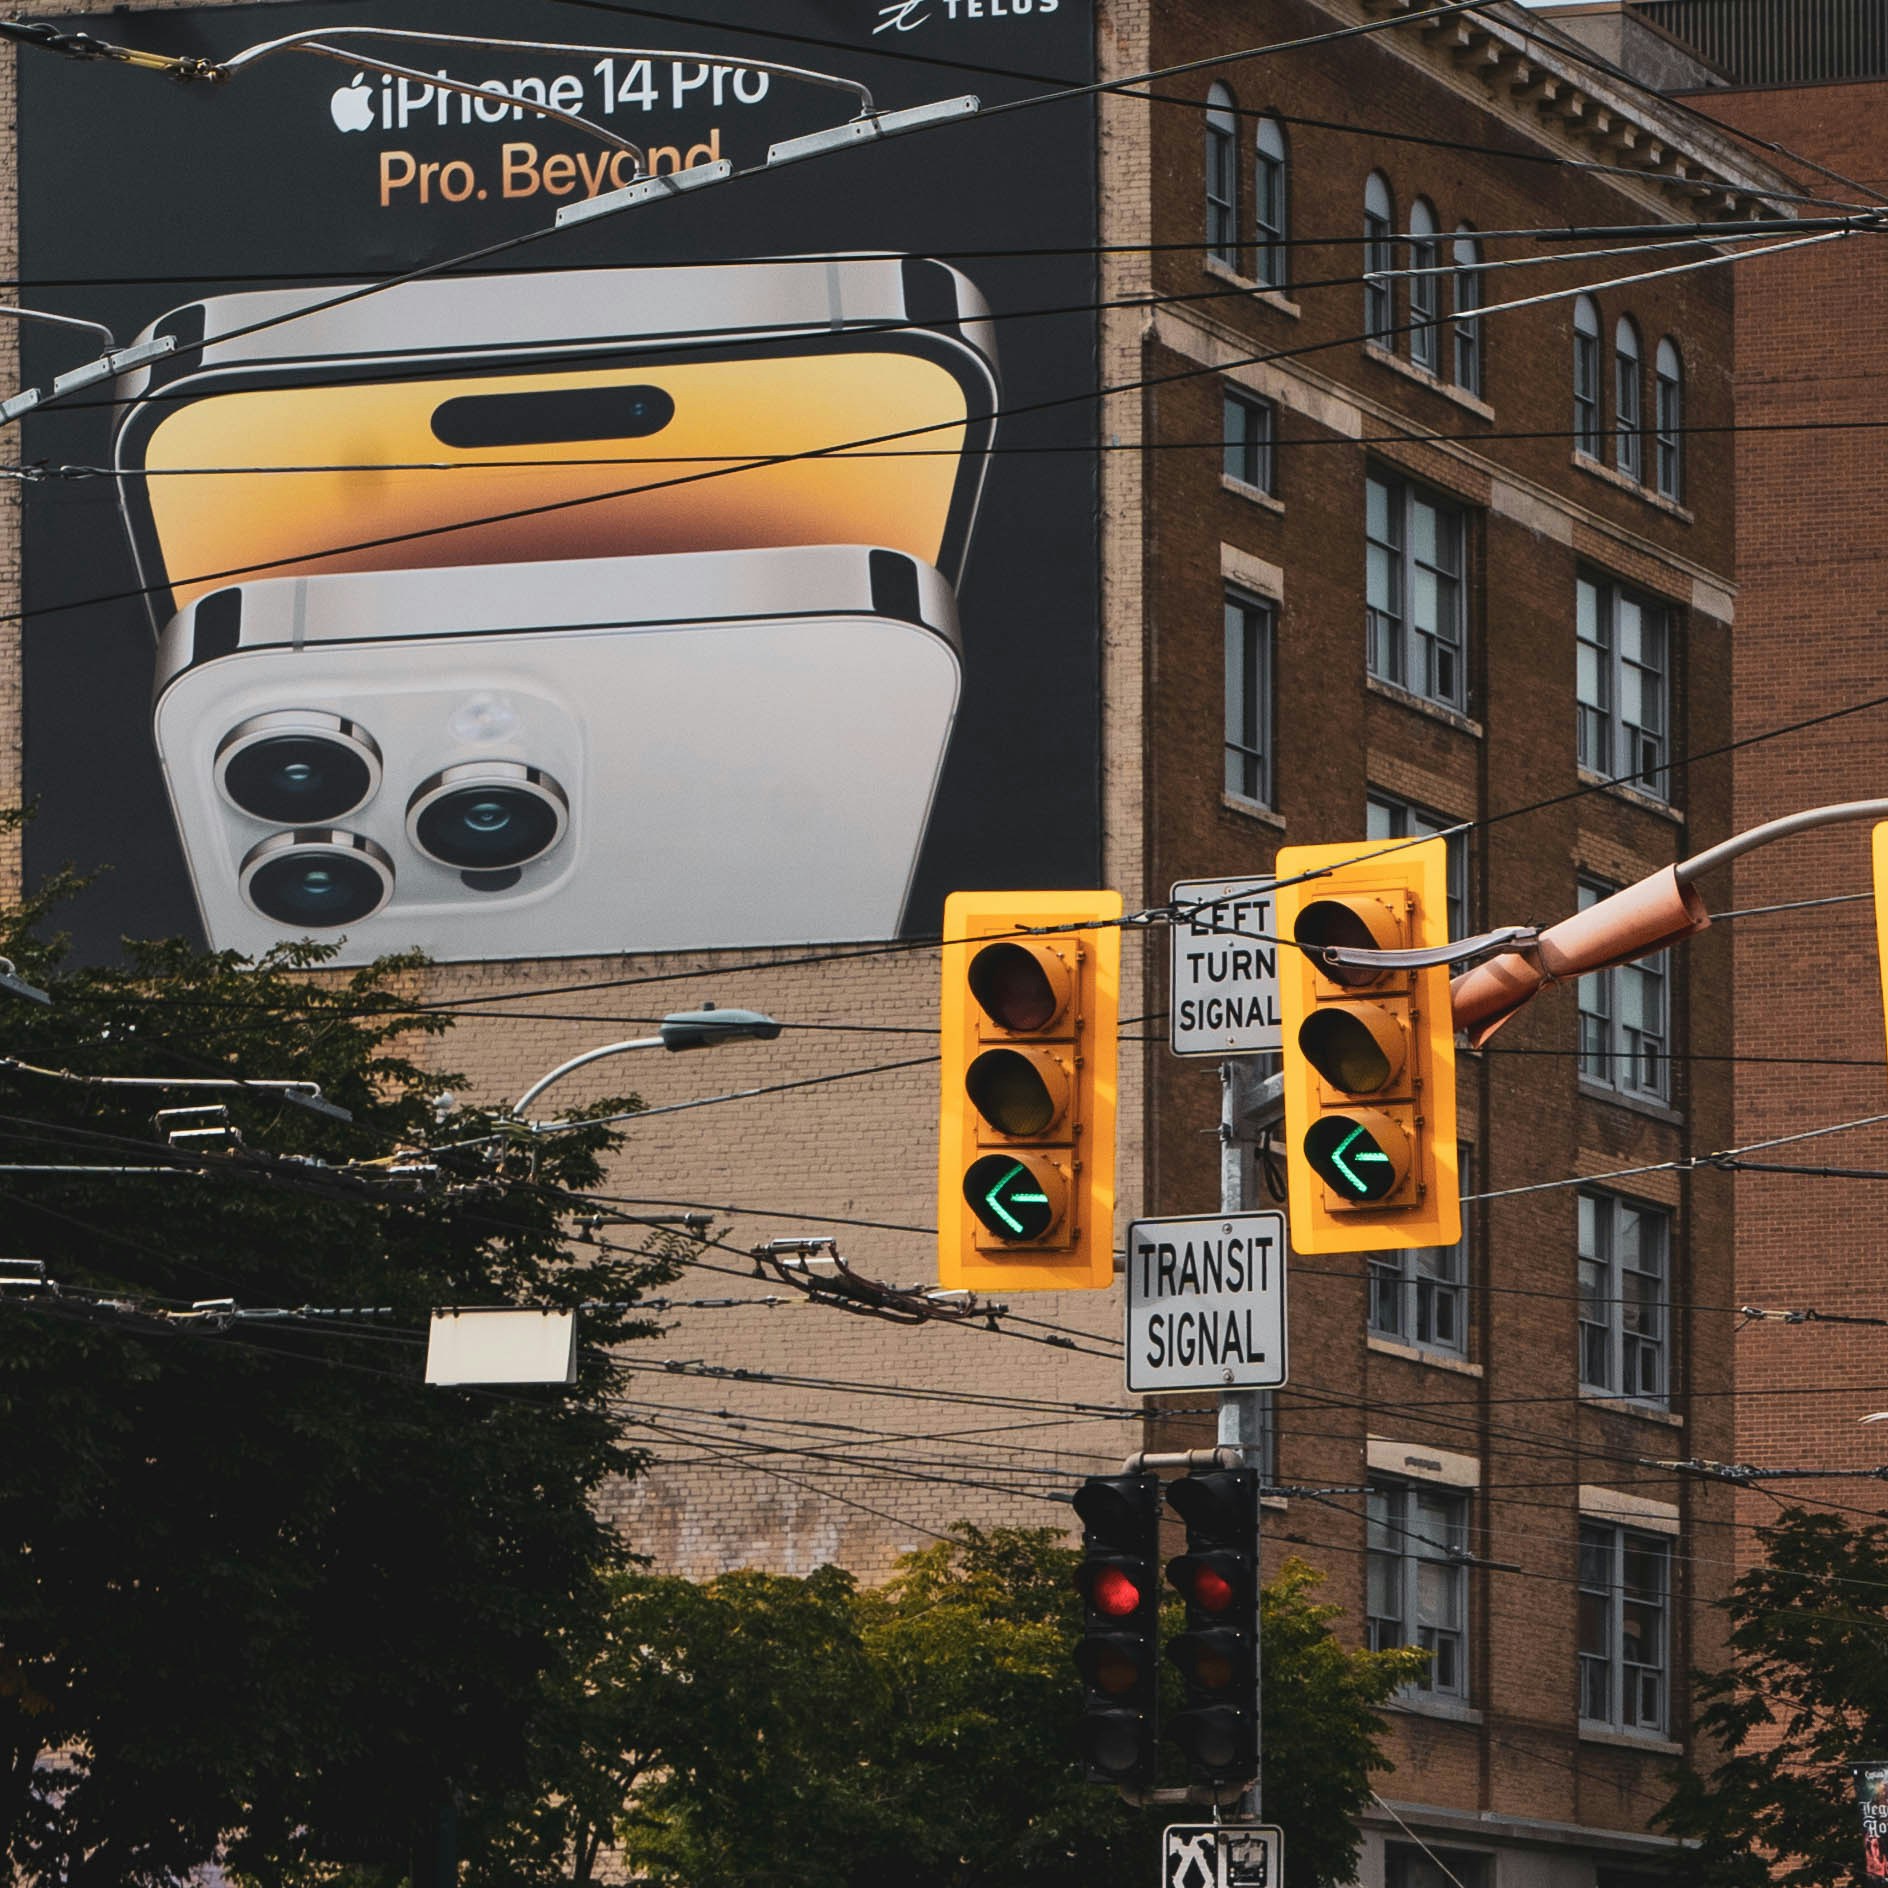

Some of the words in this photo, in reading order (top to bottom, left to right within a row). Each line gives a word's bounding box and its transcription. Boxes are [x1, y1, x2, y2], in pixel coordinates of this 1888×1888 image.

[943, 0, 1059, 19] TELUS
[381, 69, 585, 130] iPhone
[593, 58, 660, 111] 14
[673, 60, 770, 107] Pro
[380, 150, 487, 207] Pro.
[1190, 900, 1271, 938] LEFT
[1187, 949, 1277, 984] TURN
[1180, 997, 1282, 1031] SIGNAL
[1138, 1237, 1275, 1299] TRANSIT
[1147, 1310, 1266, 1368] SIGNAL
